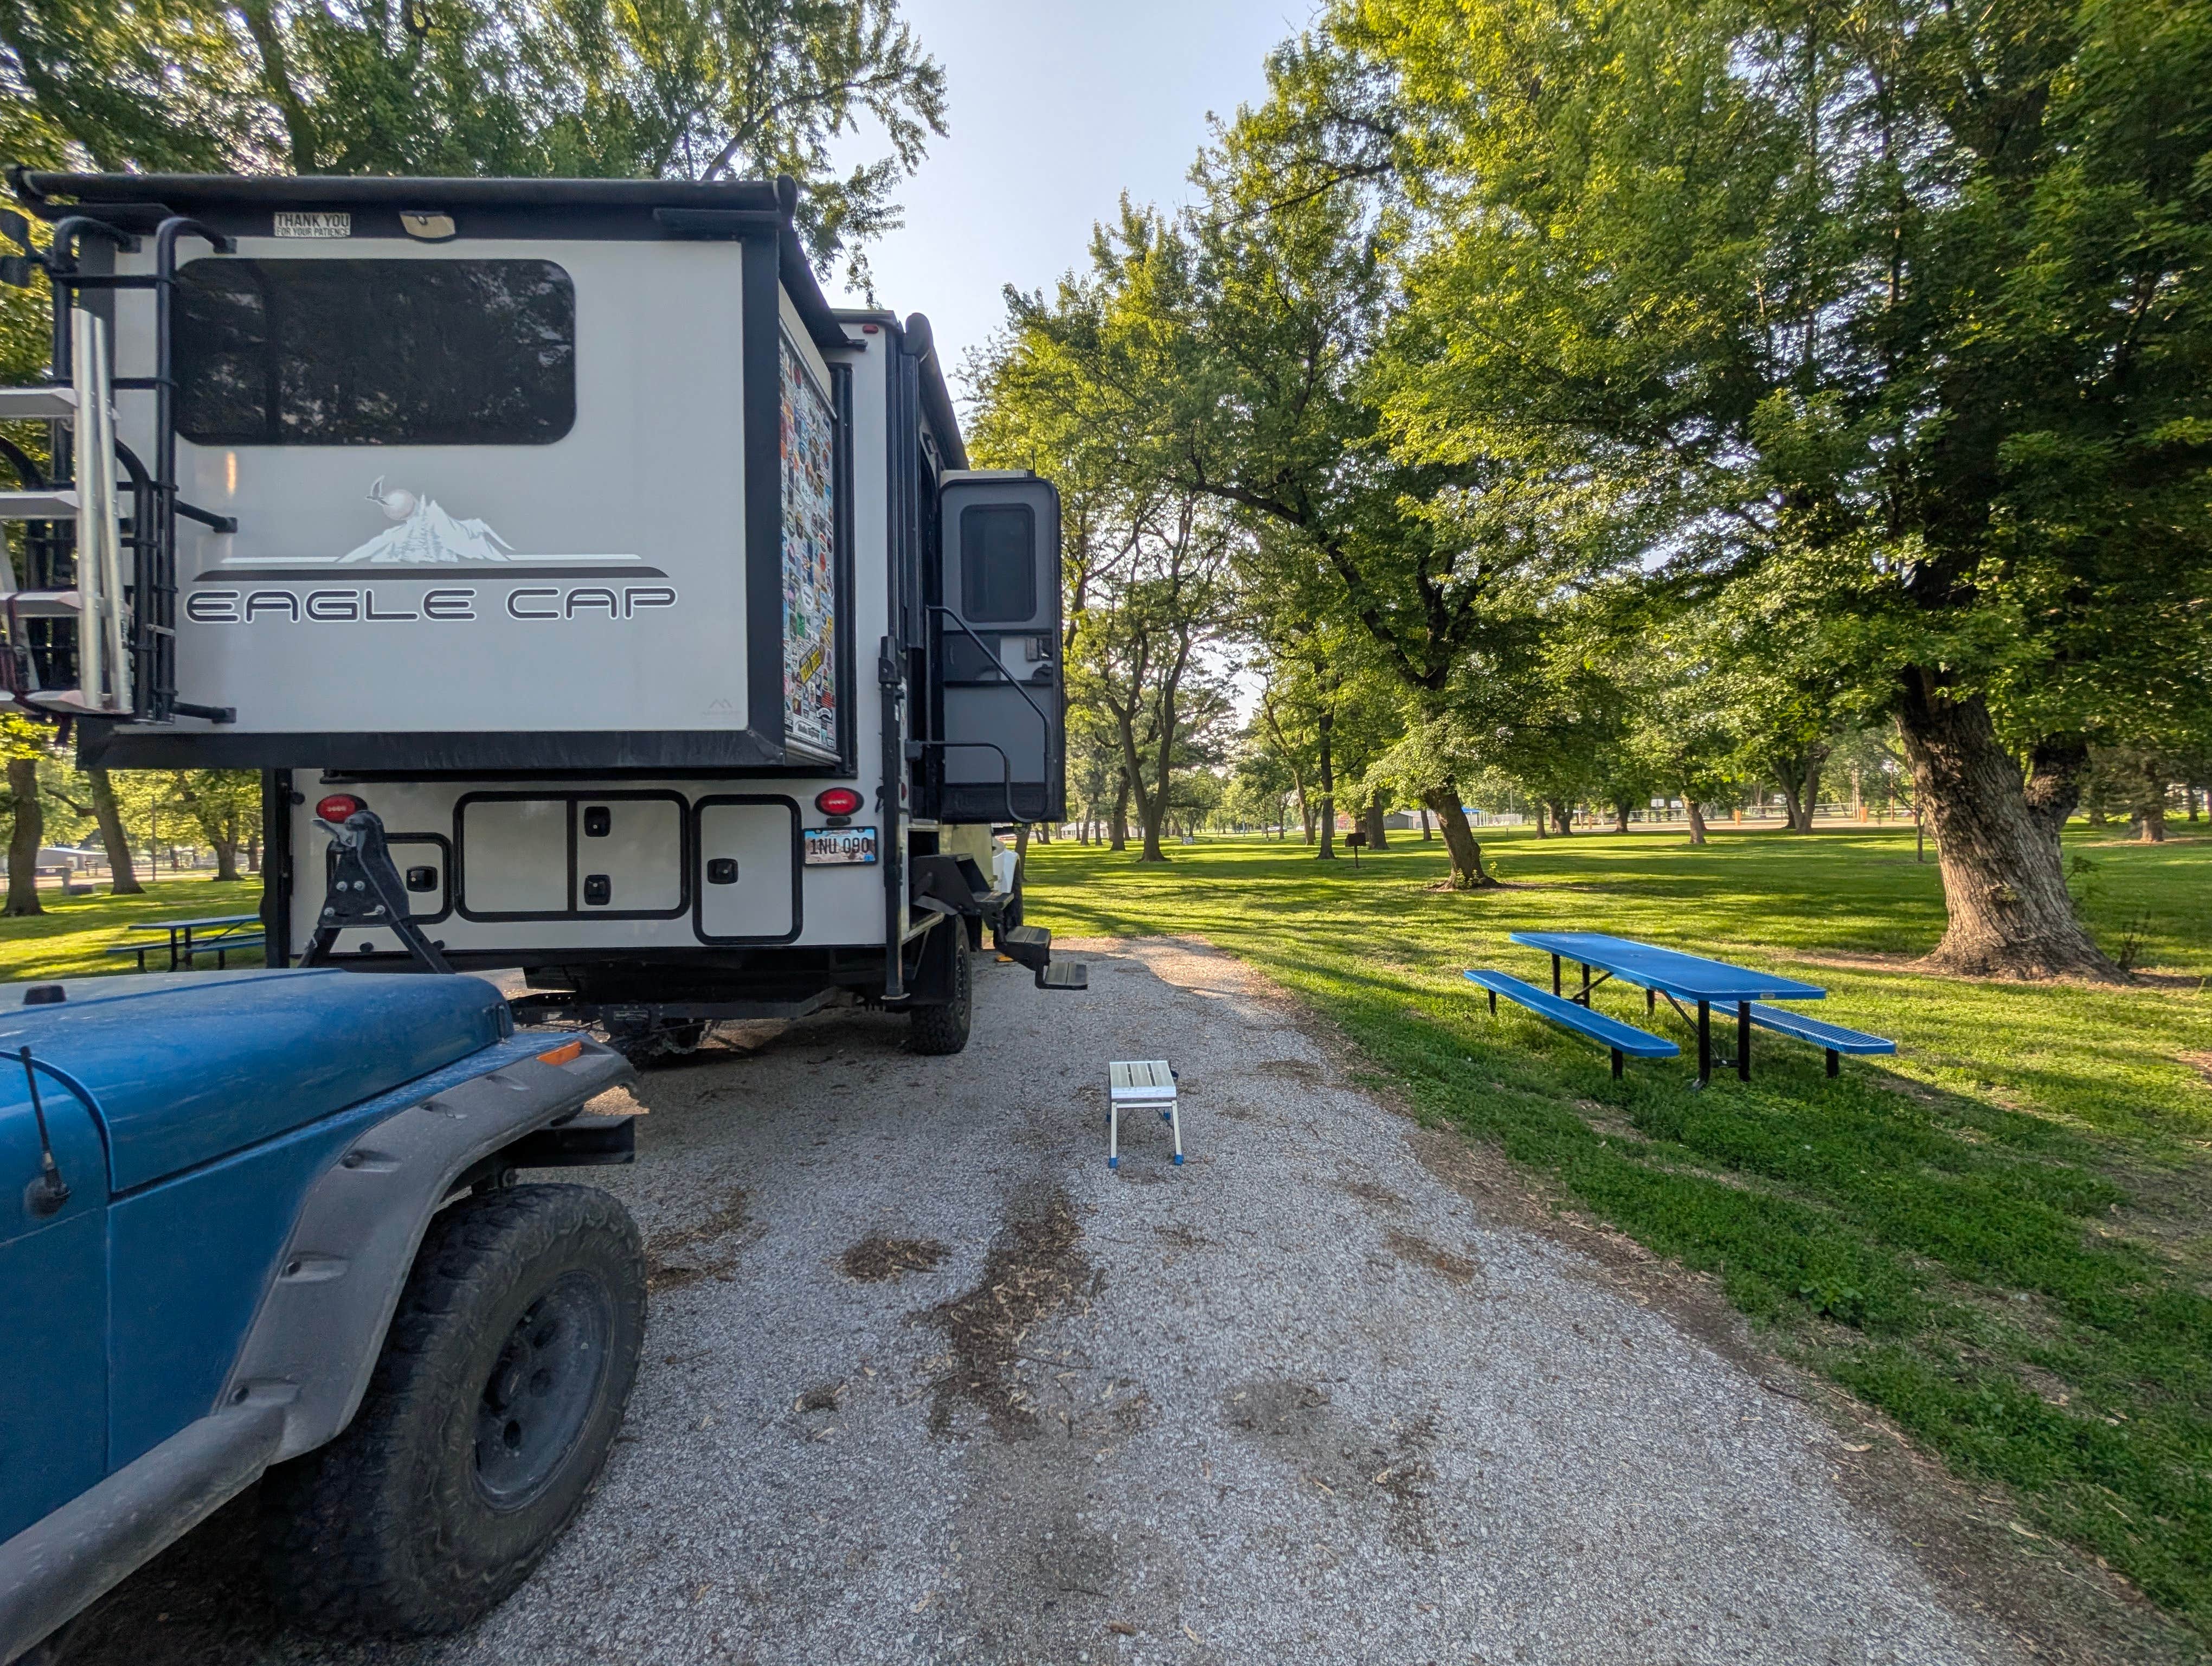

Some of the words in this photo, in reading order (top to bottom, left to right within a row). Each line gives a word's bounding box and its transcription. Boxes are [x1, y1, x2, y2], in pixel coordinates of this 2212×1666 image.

[276, 214, 320, 227] THANK
[324, 214, 349, 227] YOU
[276, 227, 291, 236] FOR
[293, 227, 312, 236] YOUR
[314, 227, 349, 236] PATIENCE
[185, 588, 477, 624] EAGLE
[505, 585, 678, 621] CAP
[811, 838, 838, 855] 1NU
